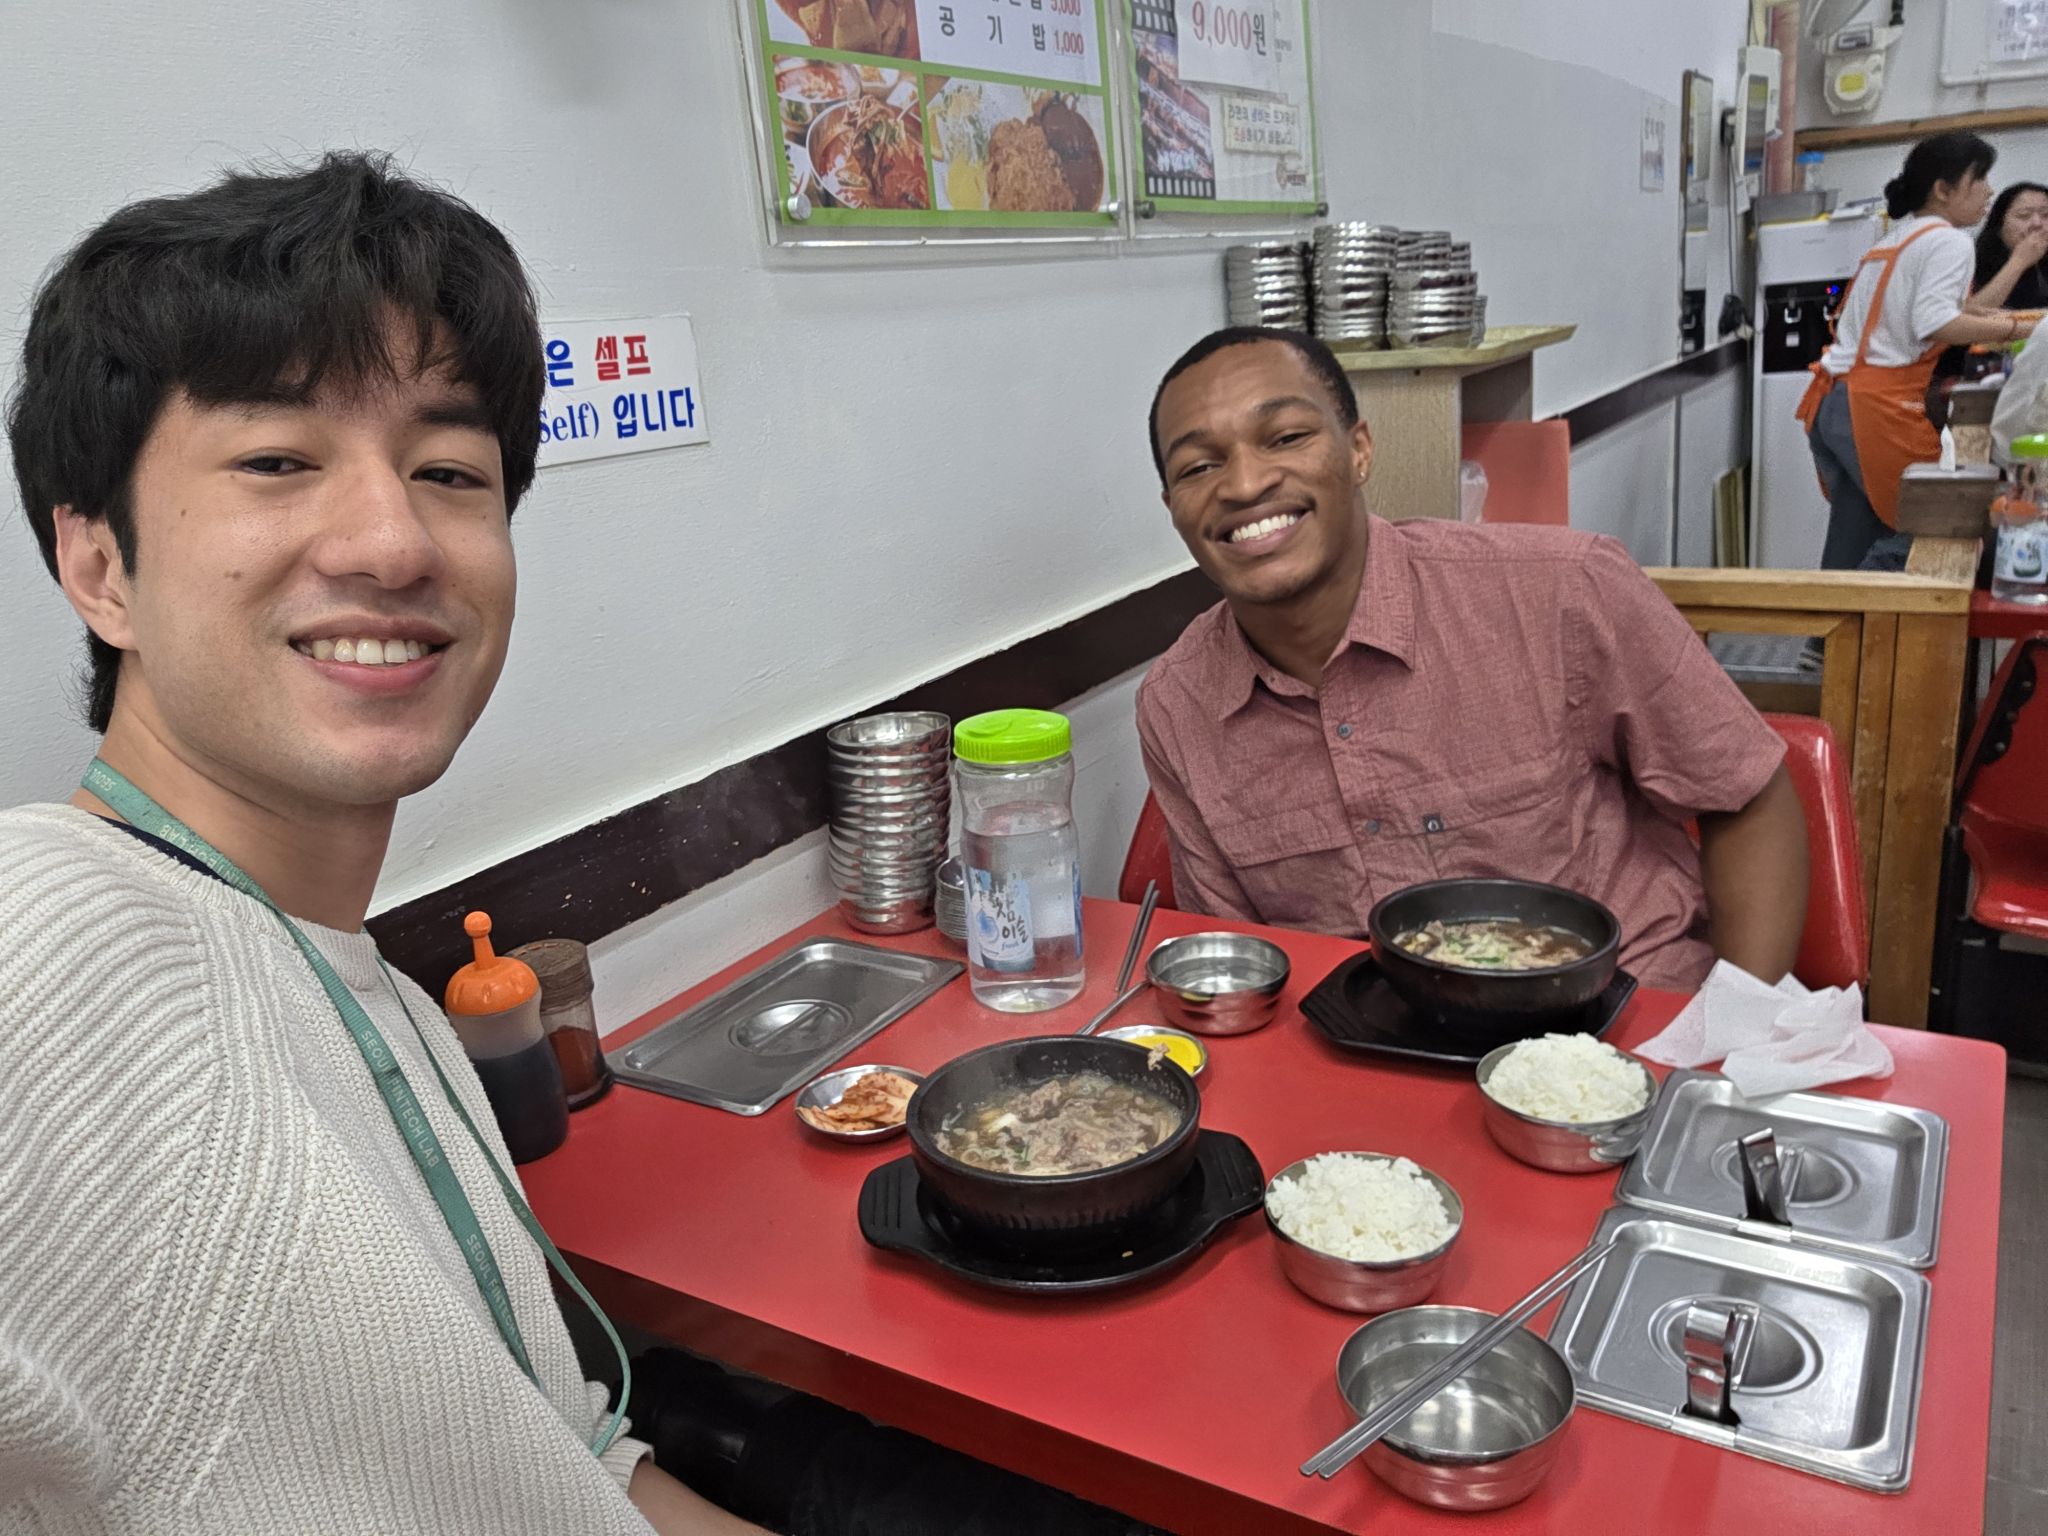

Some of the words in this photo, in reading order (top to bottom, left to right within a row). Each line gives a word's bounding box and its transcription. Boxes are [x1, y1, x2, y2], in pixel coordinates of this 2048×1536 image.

[1054, 30, 1084, 55] 1,000
[1192, 1, 1267, 56] 9,000원
[595, 335, 651, 382] 셀프
[613, 387, 695, 439] 입니다
[361, 1030, 395, 1073] SEOUL
[387, 1073, 426, 1138] FINTECH
[417, 1136, 440, 1169] LAB
[466, 1233, 491, 1280] SEOUL
